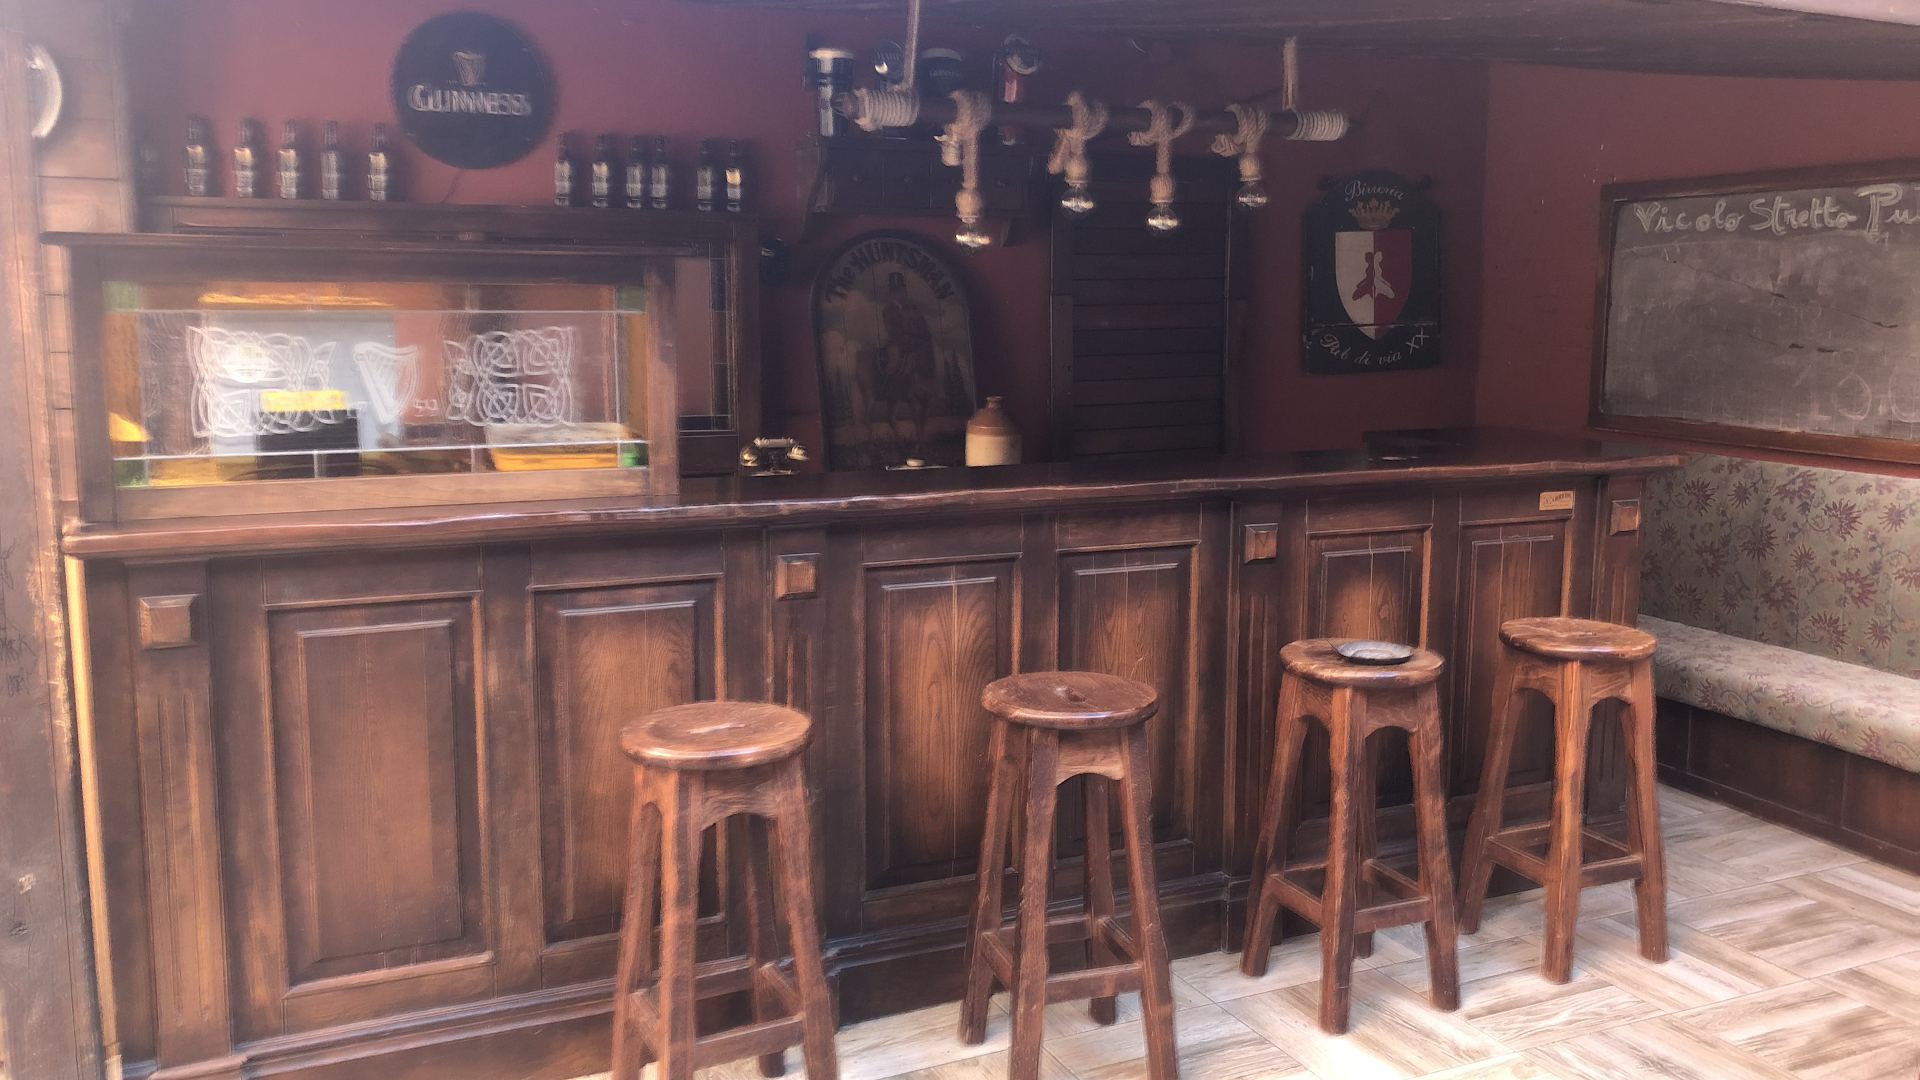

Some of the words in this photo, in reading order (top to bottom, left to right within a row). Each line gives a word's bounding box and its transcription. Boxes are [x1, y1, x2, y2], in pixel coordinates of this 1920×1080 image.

[407, 84, 532, 116] GUINNESS
[1345, 179, 1405, 202] Birreria
[1634, 199, 1745, 232] Vicolo
[1749, 196, 1857, 236] Stretto
[1853, 183, 1920, 232] Pu
[1319, 333, 1352, 361] Pub
[1354, 350, 1372, 365] di
[1377, 350, 1402, 365] via
